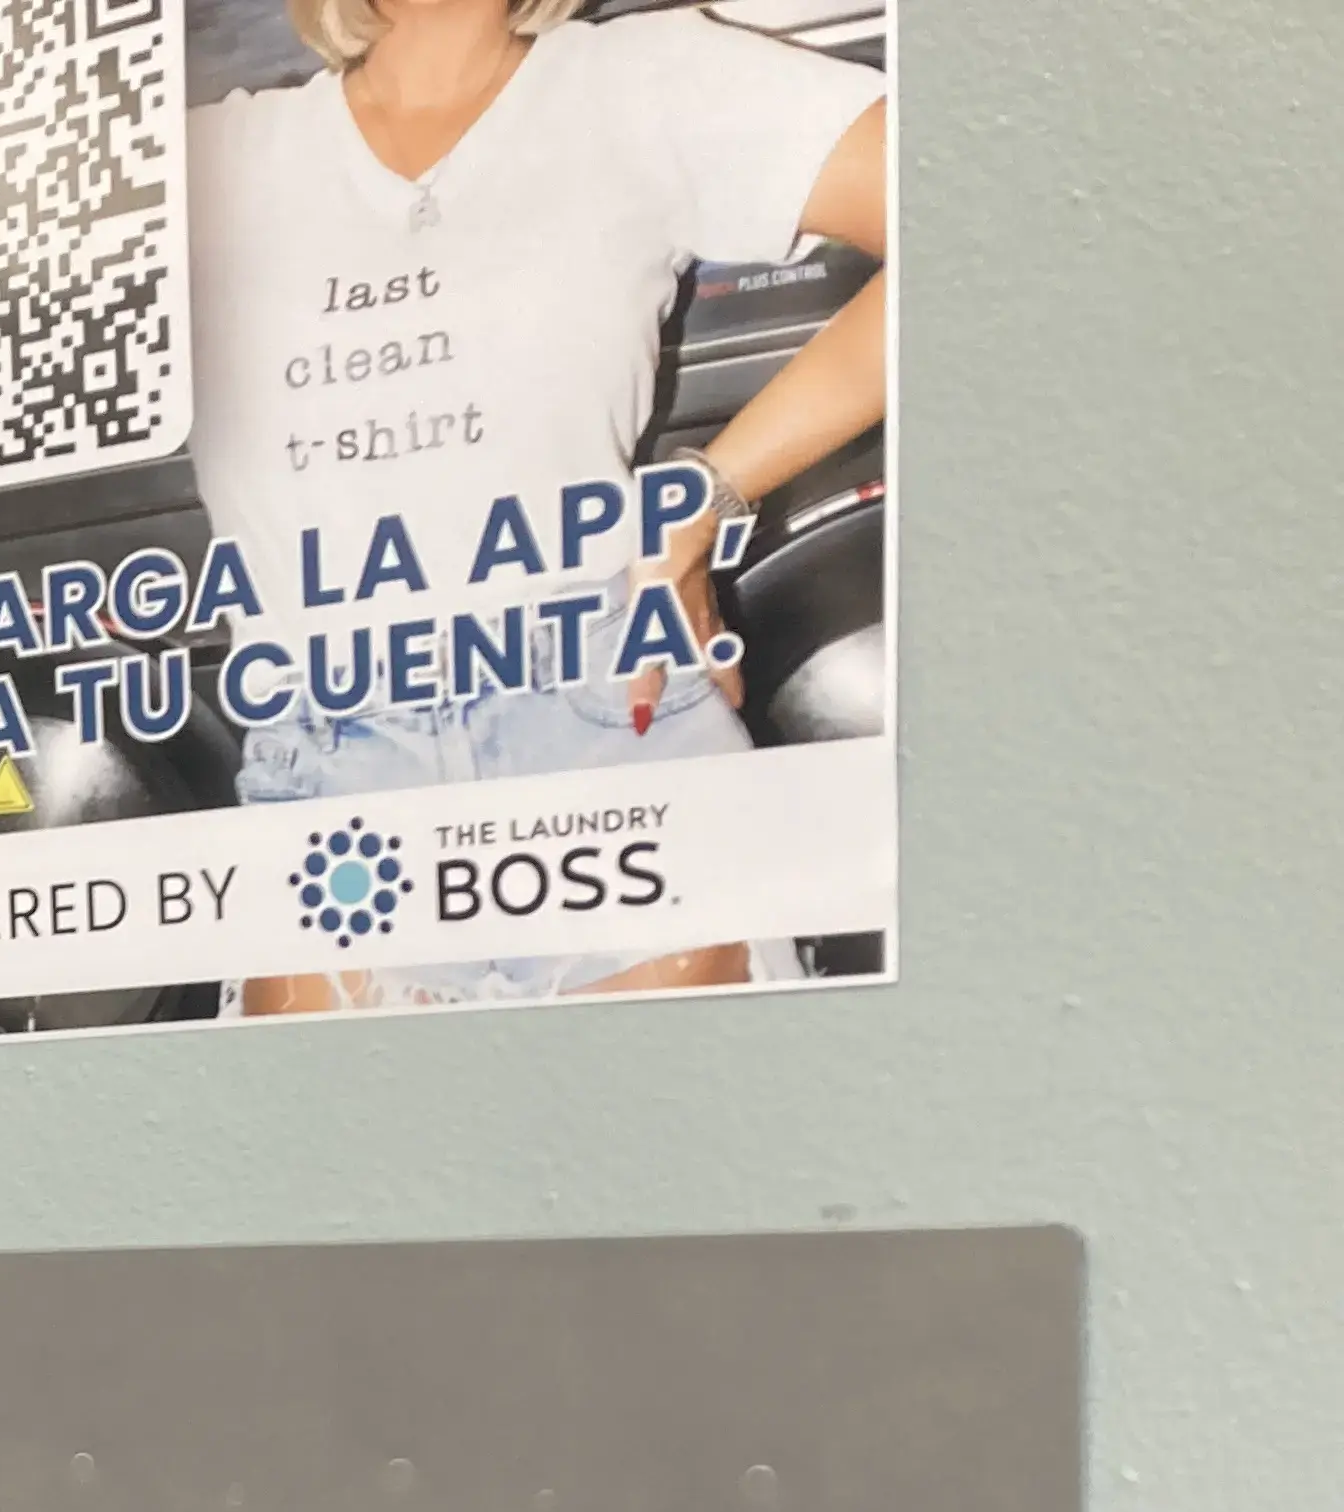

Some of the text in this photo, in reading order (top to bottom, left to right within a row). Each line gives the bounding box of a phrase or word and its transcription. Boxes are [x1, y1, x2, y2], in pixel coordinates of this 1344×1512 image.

[323, 266, 441, 314] last
[284, 330, 456, 389] clean
[285, 402, 484, 471] t-shirt
[299, 512, 430, 609] LA
[468, 461, 757, 585] APP,
[56, 648, 192, 744] TU
[218, 577, 746, 728] CUENTA.
[434, 802, 670, 849] THE LAUNDRY
[155, 866, 240, 928] BY
